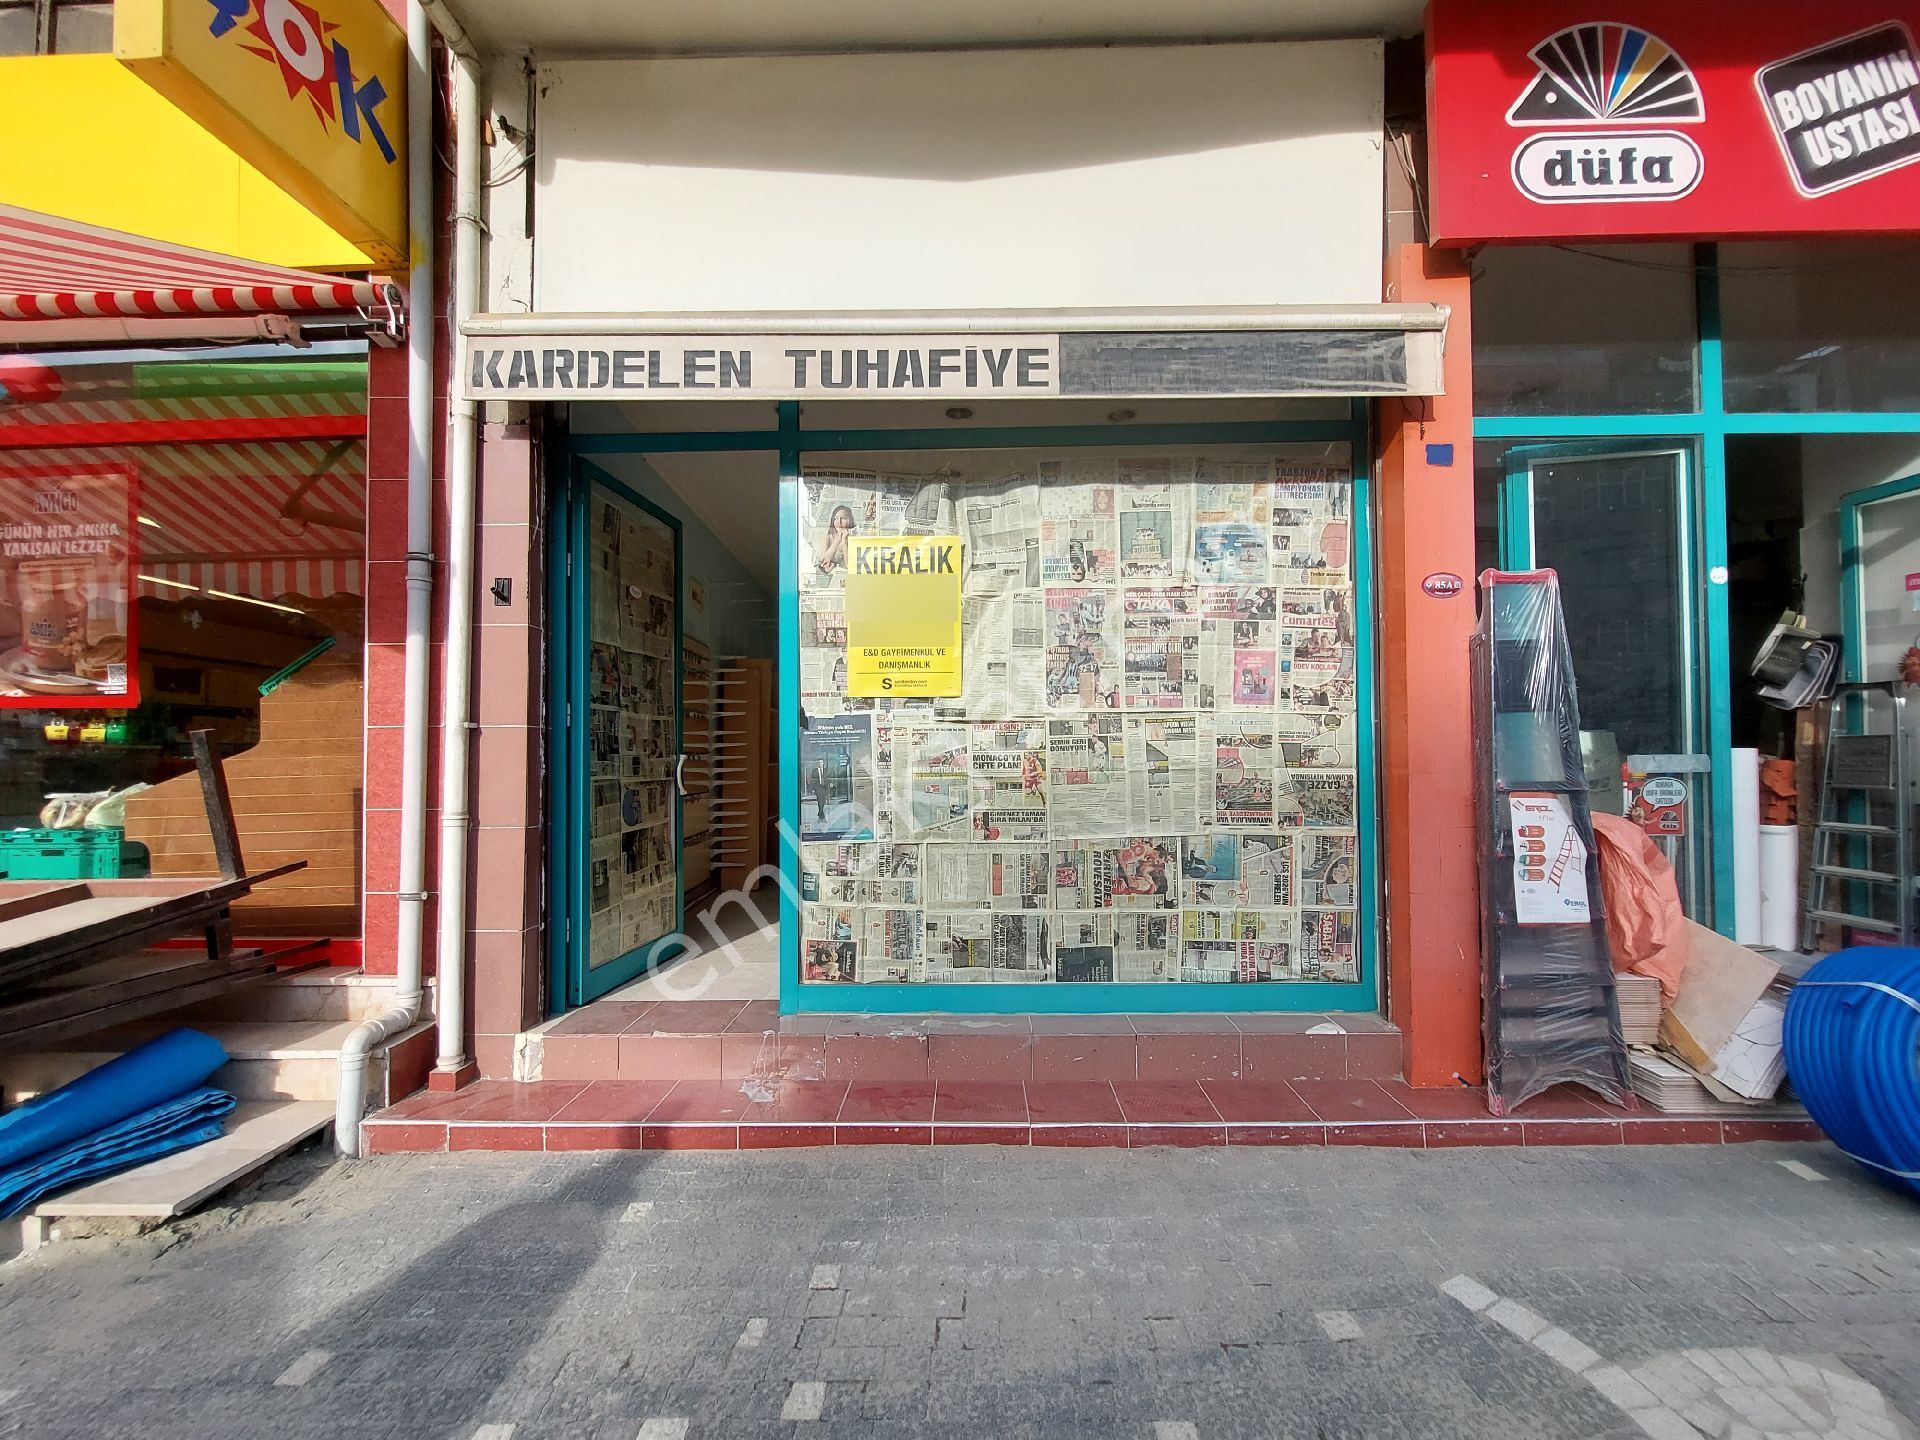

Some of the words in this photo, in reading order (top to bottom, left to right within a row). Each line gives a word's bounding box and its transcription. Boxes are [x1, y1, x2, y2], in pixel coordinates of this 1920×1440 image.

[1772, 49, 1920, 131] BOYANIN
[1543, 148, 1673, 187] düfa
[472, 350, 751, 389] KARDELEN
[786, 344, 1049, 388] TUHAFİYE
[48, 525, 72, 538] HER
[66, 540, 111, 554] LEZZET
[936, 648, 946, 656] VE
[972, 754, 1022, 762] MONACO'YA
[1307, 780, 1340, 790] GAZZE
[1323, 914, 1334, 950] SABAH
[1240, 942, 1248, 959] KURA
[1247, 942, 1256, 968] LOKUM
